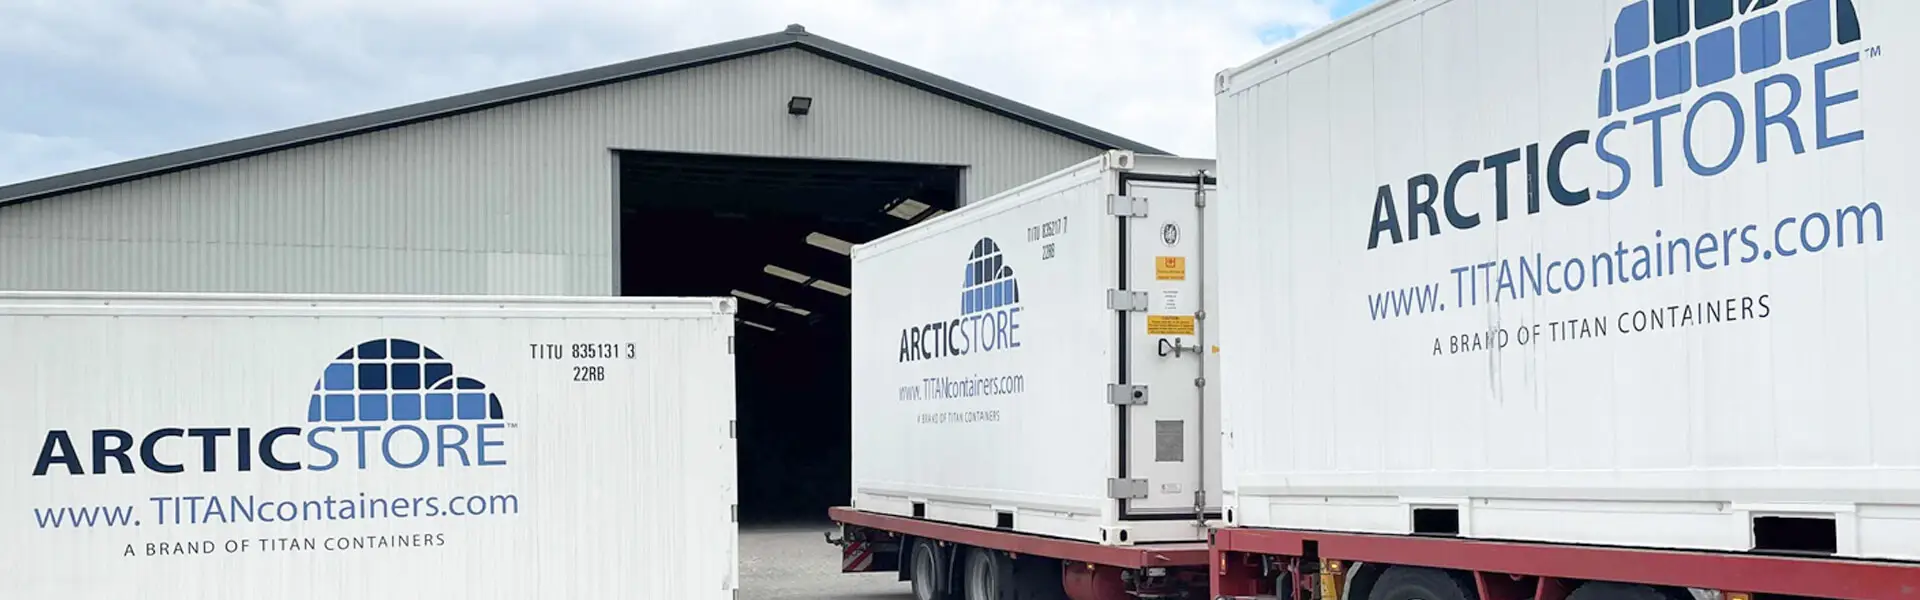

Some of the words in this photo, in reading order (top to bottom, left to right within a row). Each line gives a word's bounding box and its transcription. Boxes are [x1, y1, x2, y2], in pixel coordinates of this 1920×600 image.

[1367, 52, 1864, 249] ARCTICSTORE
[1368, 281, 1446, 322] www.
[1450, 202, 1884, 309] TITANcontainers.com
[899, 307, 1021, 363] ARCTICSTORE
[1433, 337, 1443, 357] A
[1517, 323, 1541, 346] OF
[1549, 316, 1608, 342] TITAN
[1617, 294, 1772, 334] CONTAINERS
[530, 343, 562, 360] TITU
[571, 343, 619, 359] 835131
[627, 343, 635, 359] 3
[573, 366, 605, 381] 22RB
[923, 374, 1024, 399] TITANcontainers.com
[32, 423, 507, 476] ARCTICSTORE
[34, 504, 141, 528] www.
[151, 492, 519, 525] TITANcontainers.com
[124, 545, 136, 556] A
[146, 541, 215, 556] BRAND
[225, 541, 250, 553] OF
[260, 538, 316, 551] TITAN
[324, 533, 446, 550] CONTAINERS
